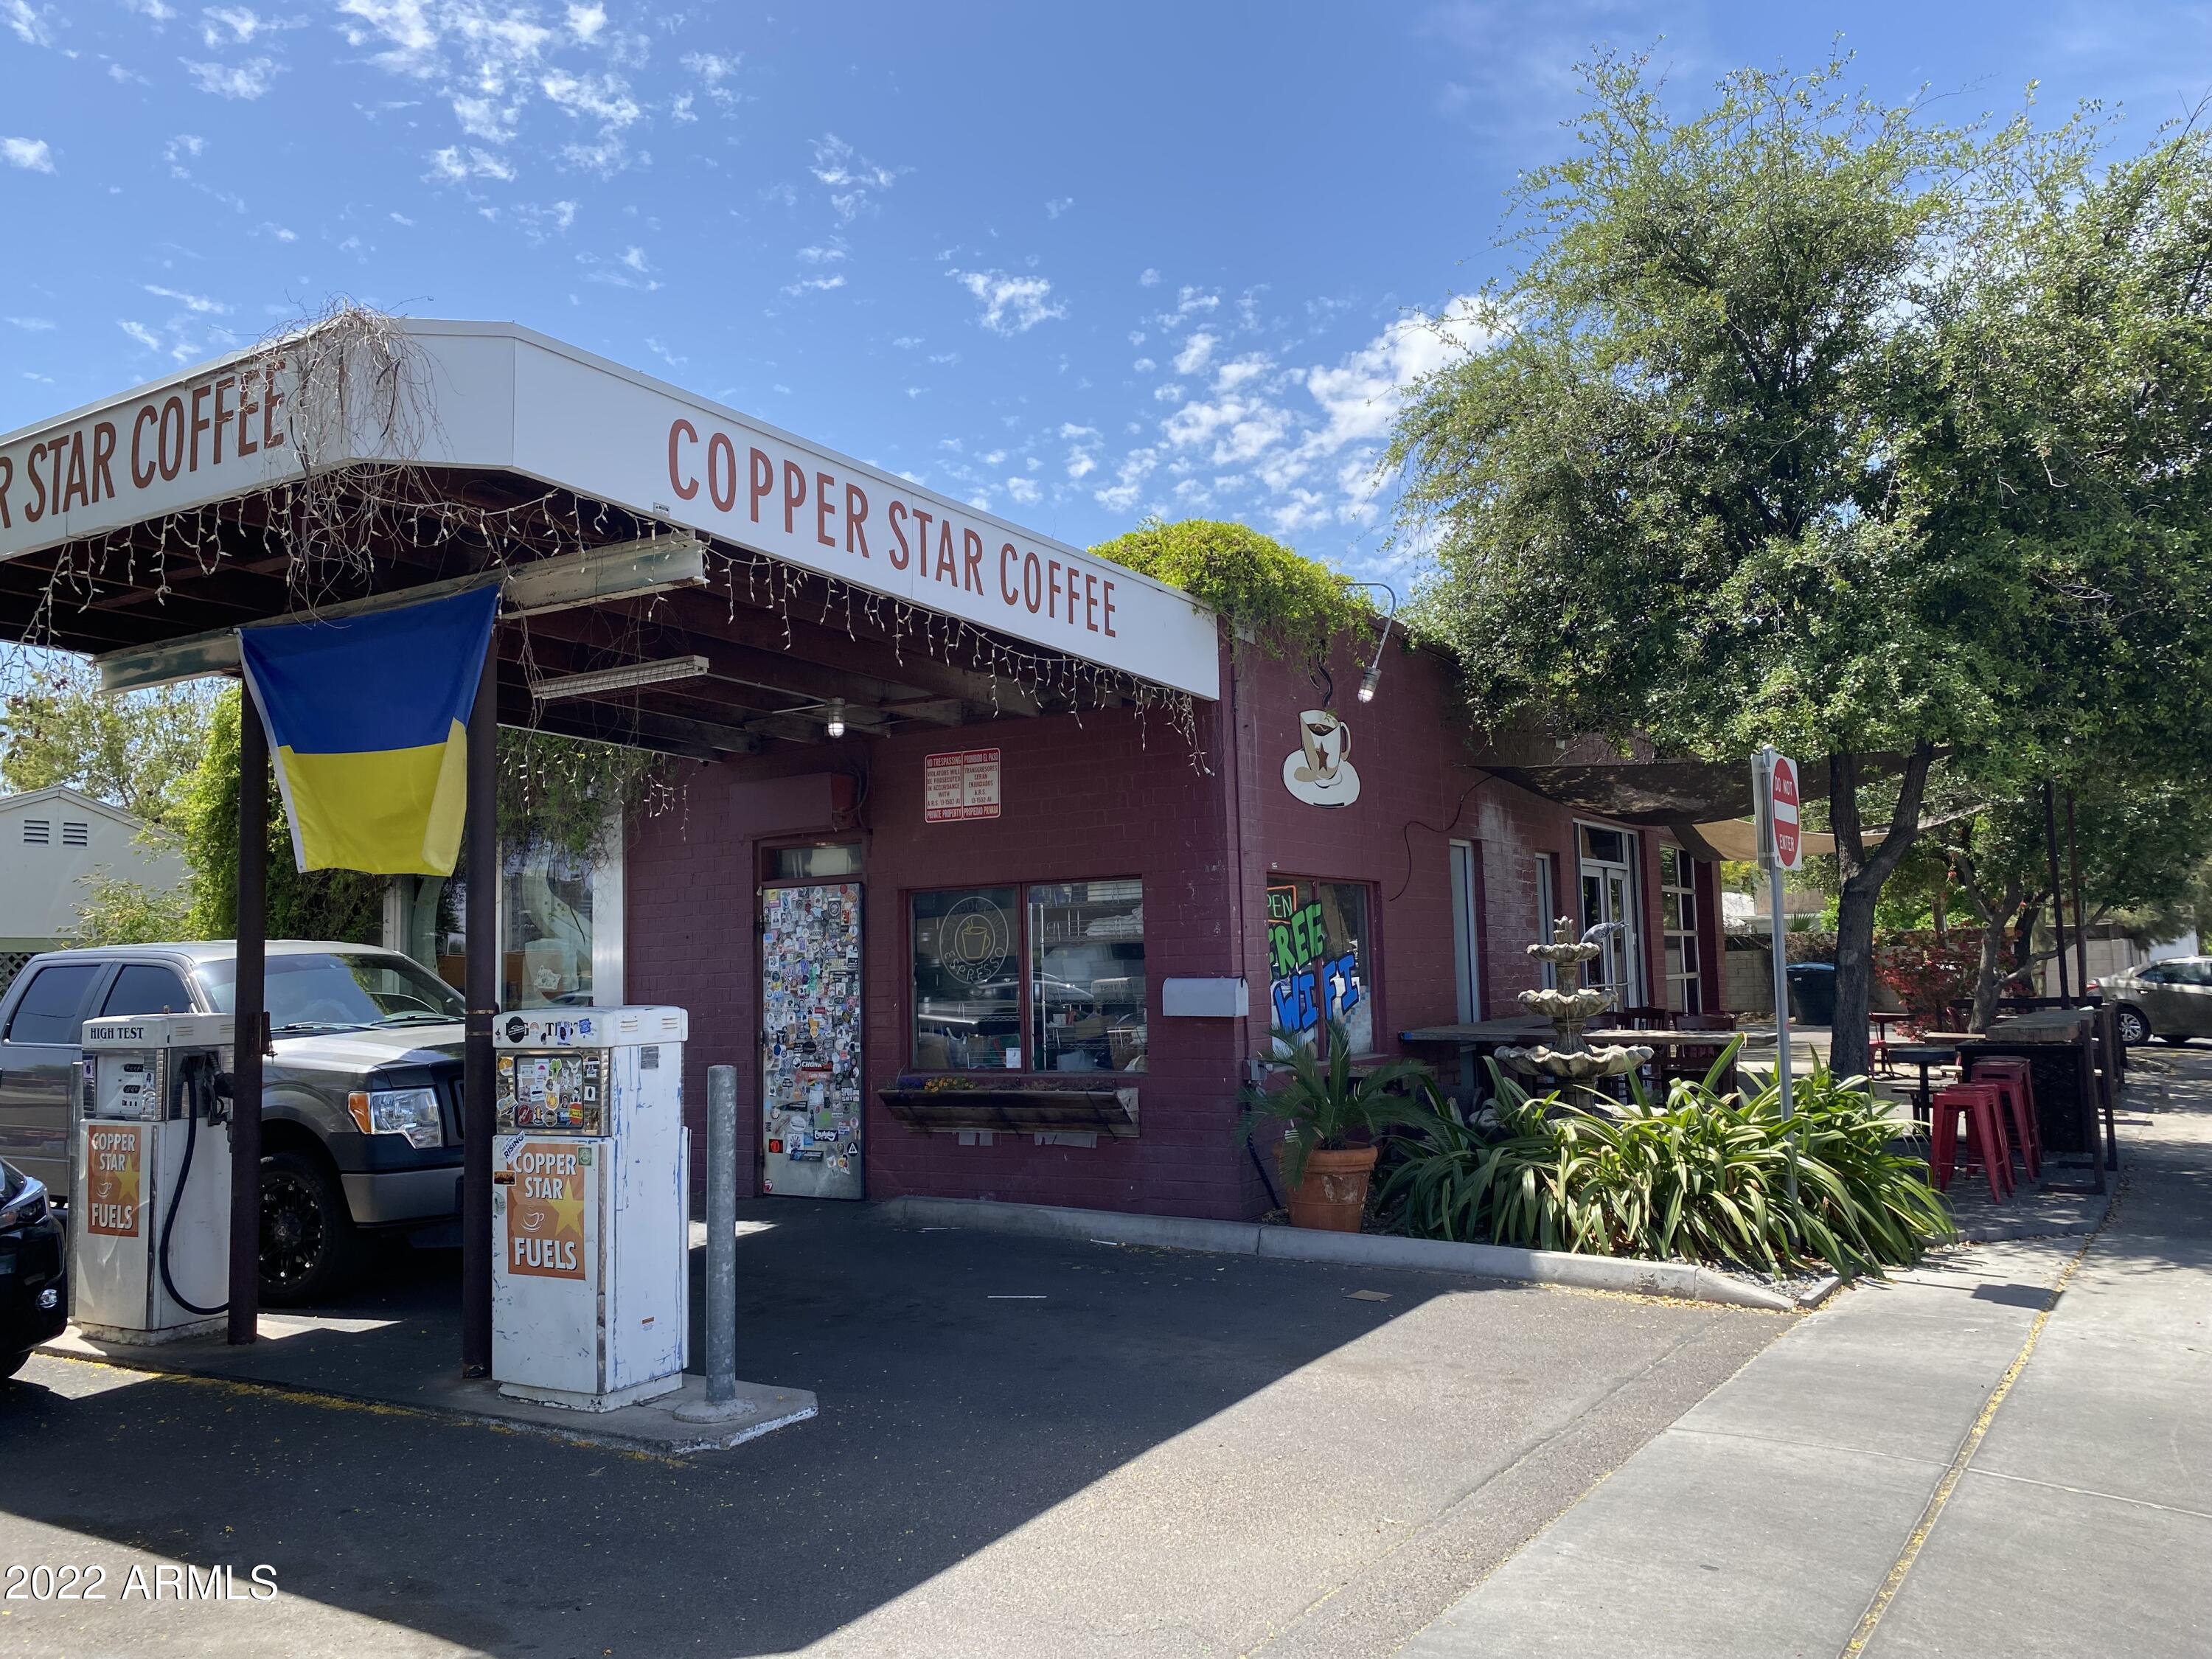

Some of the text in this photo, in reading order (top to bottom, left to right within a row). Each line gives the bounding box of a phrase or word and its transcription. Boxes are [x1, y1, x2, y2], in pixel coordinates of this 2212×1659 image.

[24, 422, 115, 522] STAR
[131, 358, 287, 489] COFFEE
[668, 418, 1117, 639] COPPER STAR COFFEE
[933, 756, 961, 766] TRESPASSING
[1774, 776, 1792, 796] DO NOT
[1779, 834, 1795, 852] ENTER
[1267, 894, 1293, 918] PEN
[1268, 902, 1324, 981] FREE
[945, 947, 1005, 981] ESPRESSO
[90, 1027, 144, 1040] HIGH TEST
[91, 1133, 136, 1152] COPPER
[100, 1153, 125, 1171] STAR
[512, 1152, 577, 1175] COPPER
[525, 1177, 563, 1199] STAR
[91, 1203, 133, 1230] FUELS
[515, 1237, 578, 1270] FUELS
